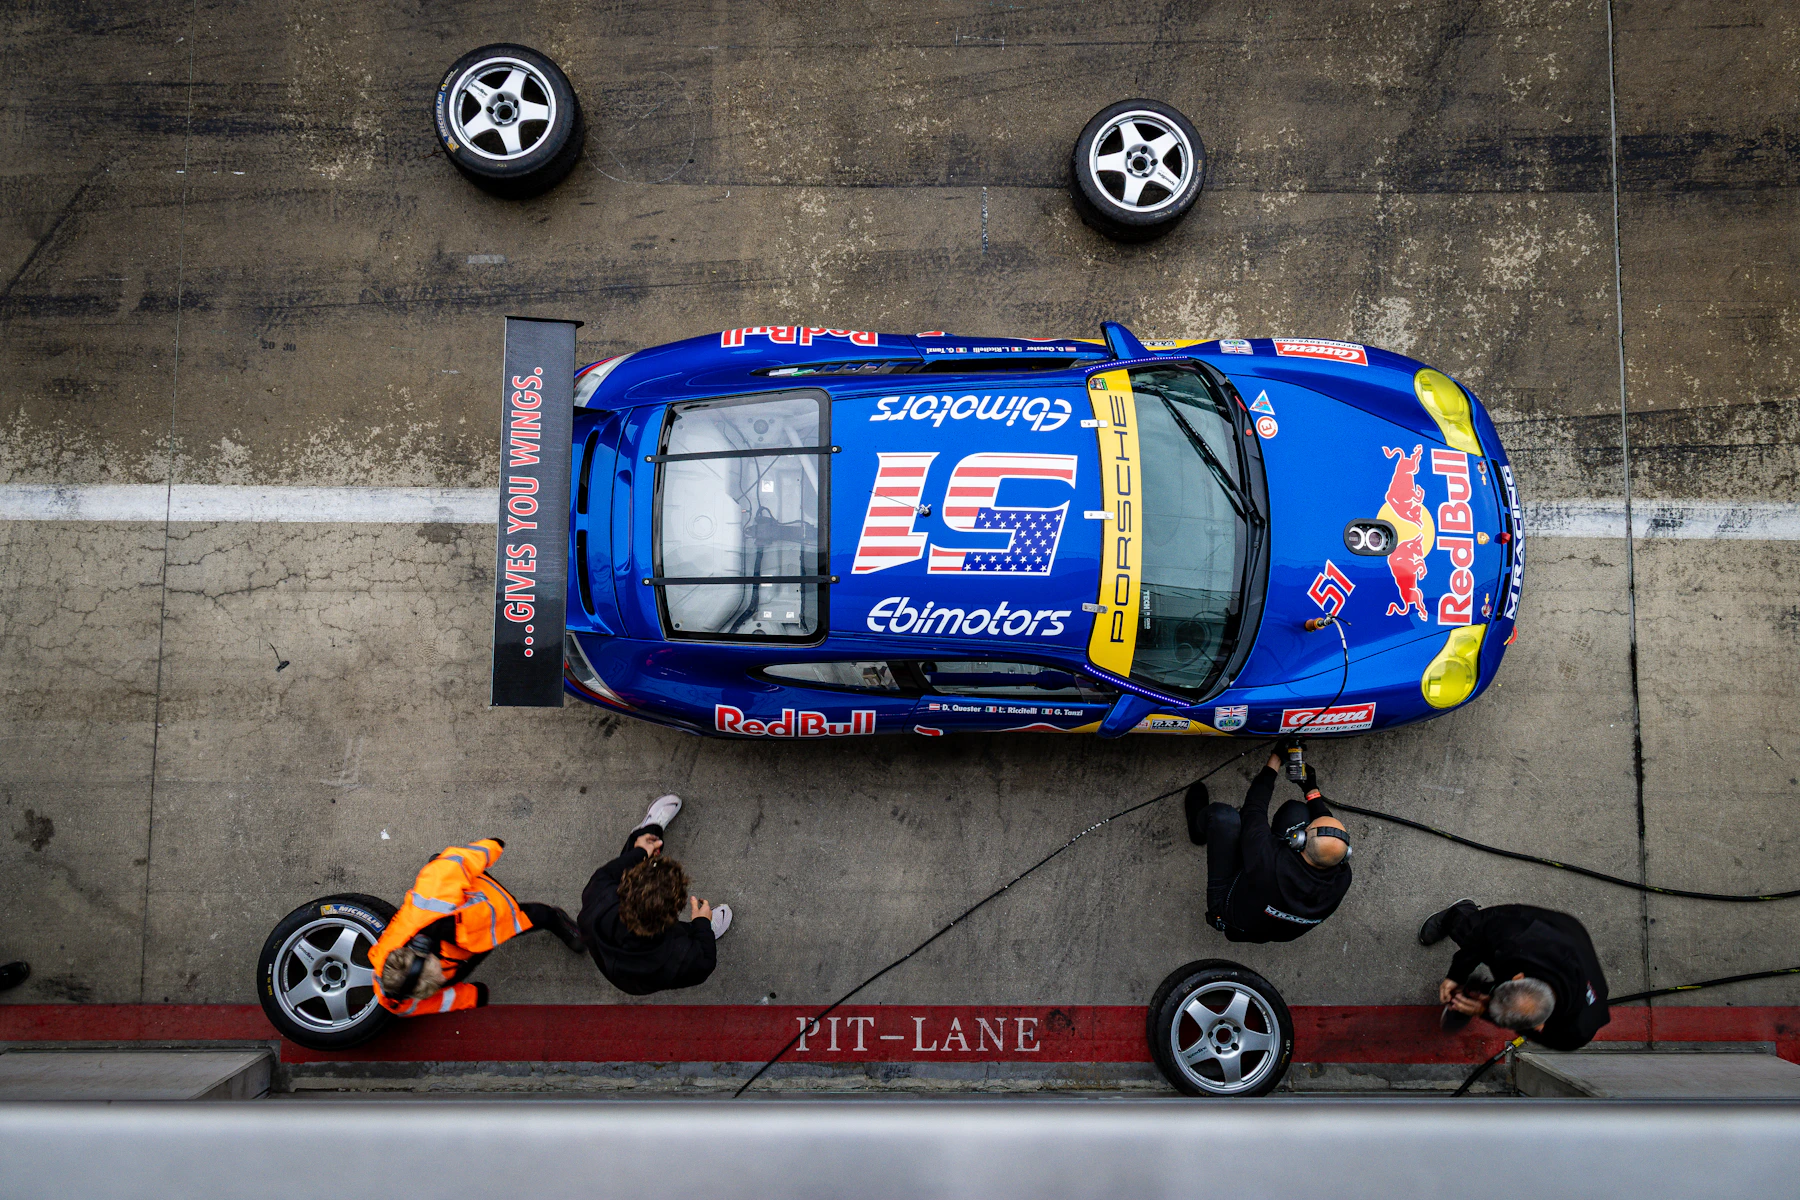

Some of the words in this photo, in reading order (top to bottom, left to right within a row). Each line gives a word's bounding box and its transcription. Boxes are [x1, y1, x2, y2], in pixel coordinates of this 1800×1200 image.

[437, 93, 448, 138] MICHELIN
[1274, 339, 1363, 350] carrera-toys.com
[1281, 344, 1360, 360] Carrera
[510, 366, 543, 467] WINGS.
[869, 395, 1073, 431] Ebimotors
[507, 476, 539, 534] YOU
[1431, 448, 1474, 534] Bull
[851, 452, 1078, 576] 51
[1109, 395, 1132, 643] PORSCHE
[1504, 465, 1524, 587] RACING
[504, 543, 537, 658] ...GIVES
[1307, 559, 1356, 617] 51
[1437, 535, 1474, 626] Red
[867, 597, 1072, 636] Ebimotors
[715, 704, 795, 737] Red
[798, 710, 876, 737] Bull
[952, 705, 981, 713] Quester
[1007, 706, 1038, 715] Riccitelli
[1054, 708, 1063, 716] G.
[1280, 723, 1371, 732] caera-toys.com
[1288, 710, 1369, 725] Carrera
[338, 905, 383, 929] MICHELIN
[796, 1016, 1040, 1051] PIT-LANE
